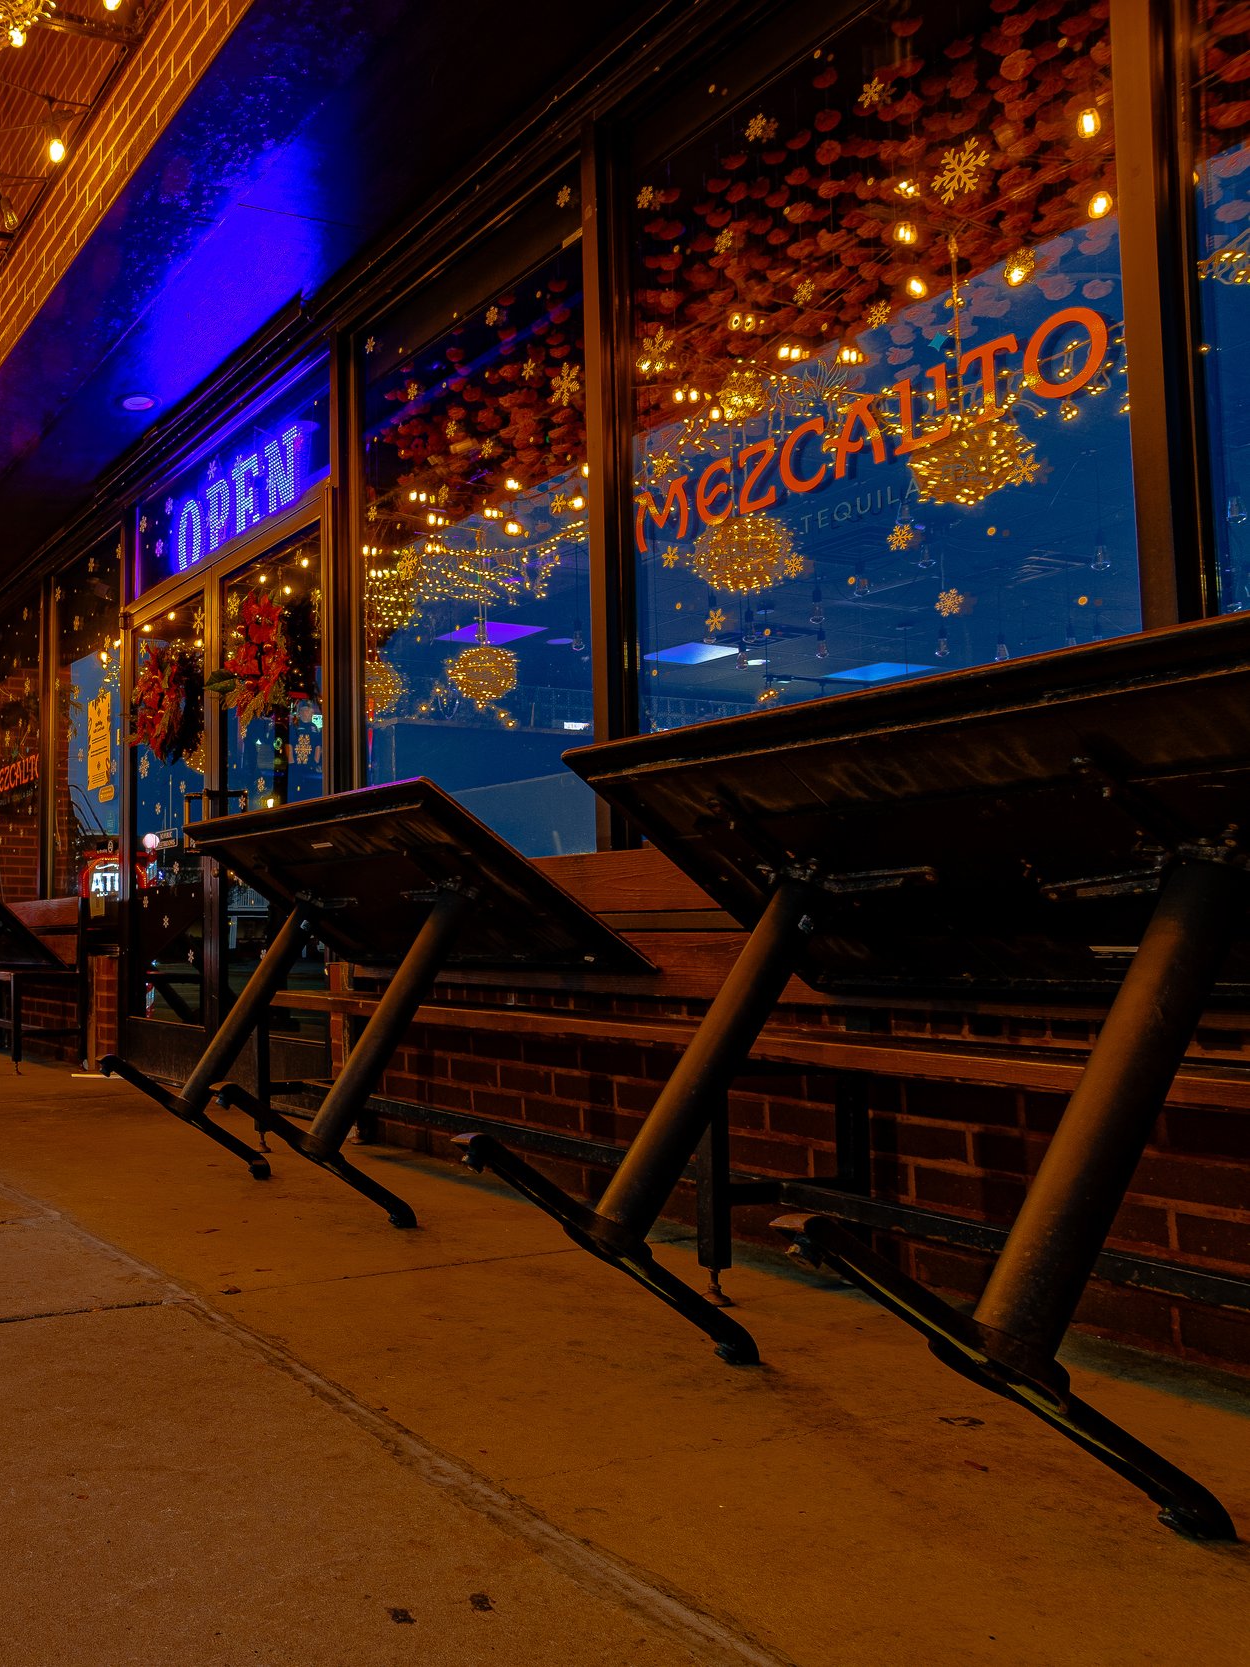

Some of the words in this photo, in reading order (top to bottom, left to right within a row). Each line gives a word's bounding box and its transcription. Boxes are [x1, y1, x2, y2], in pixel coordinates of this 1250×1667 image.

[178, 425, 299, 571] OPEN
[635, 306, 1109, 553] MEZCALITO
[800, 477, 921, 534] TEQUILA
